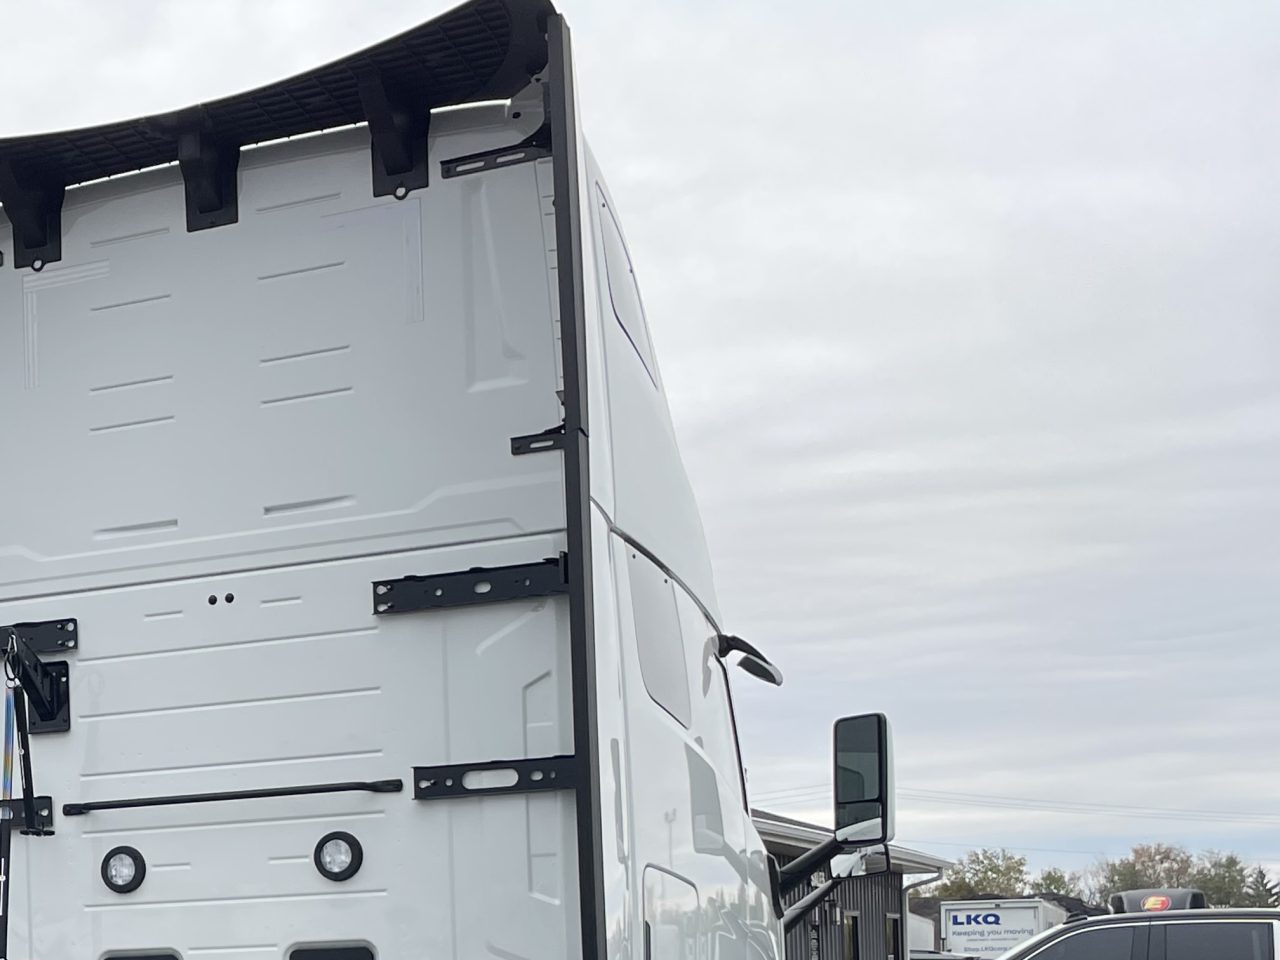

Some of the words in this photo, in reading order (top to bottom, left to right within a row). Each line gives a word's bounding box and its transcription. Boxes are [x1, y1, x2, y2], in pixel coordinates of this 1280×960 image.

[952, 913, 1001, 926] LKQ
[952, 929, 985, 937] Keeping
[1004, 928, 1034, 936] moving
